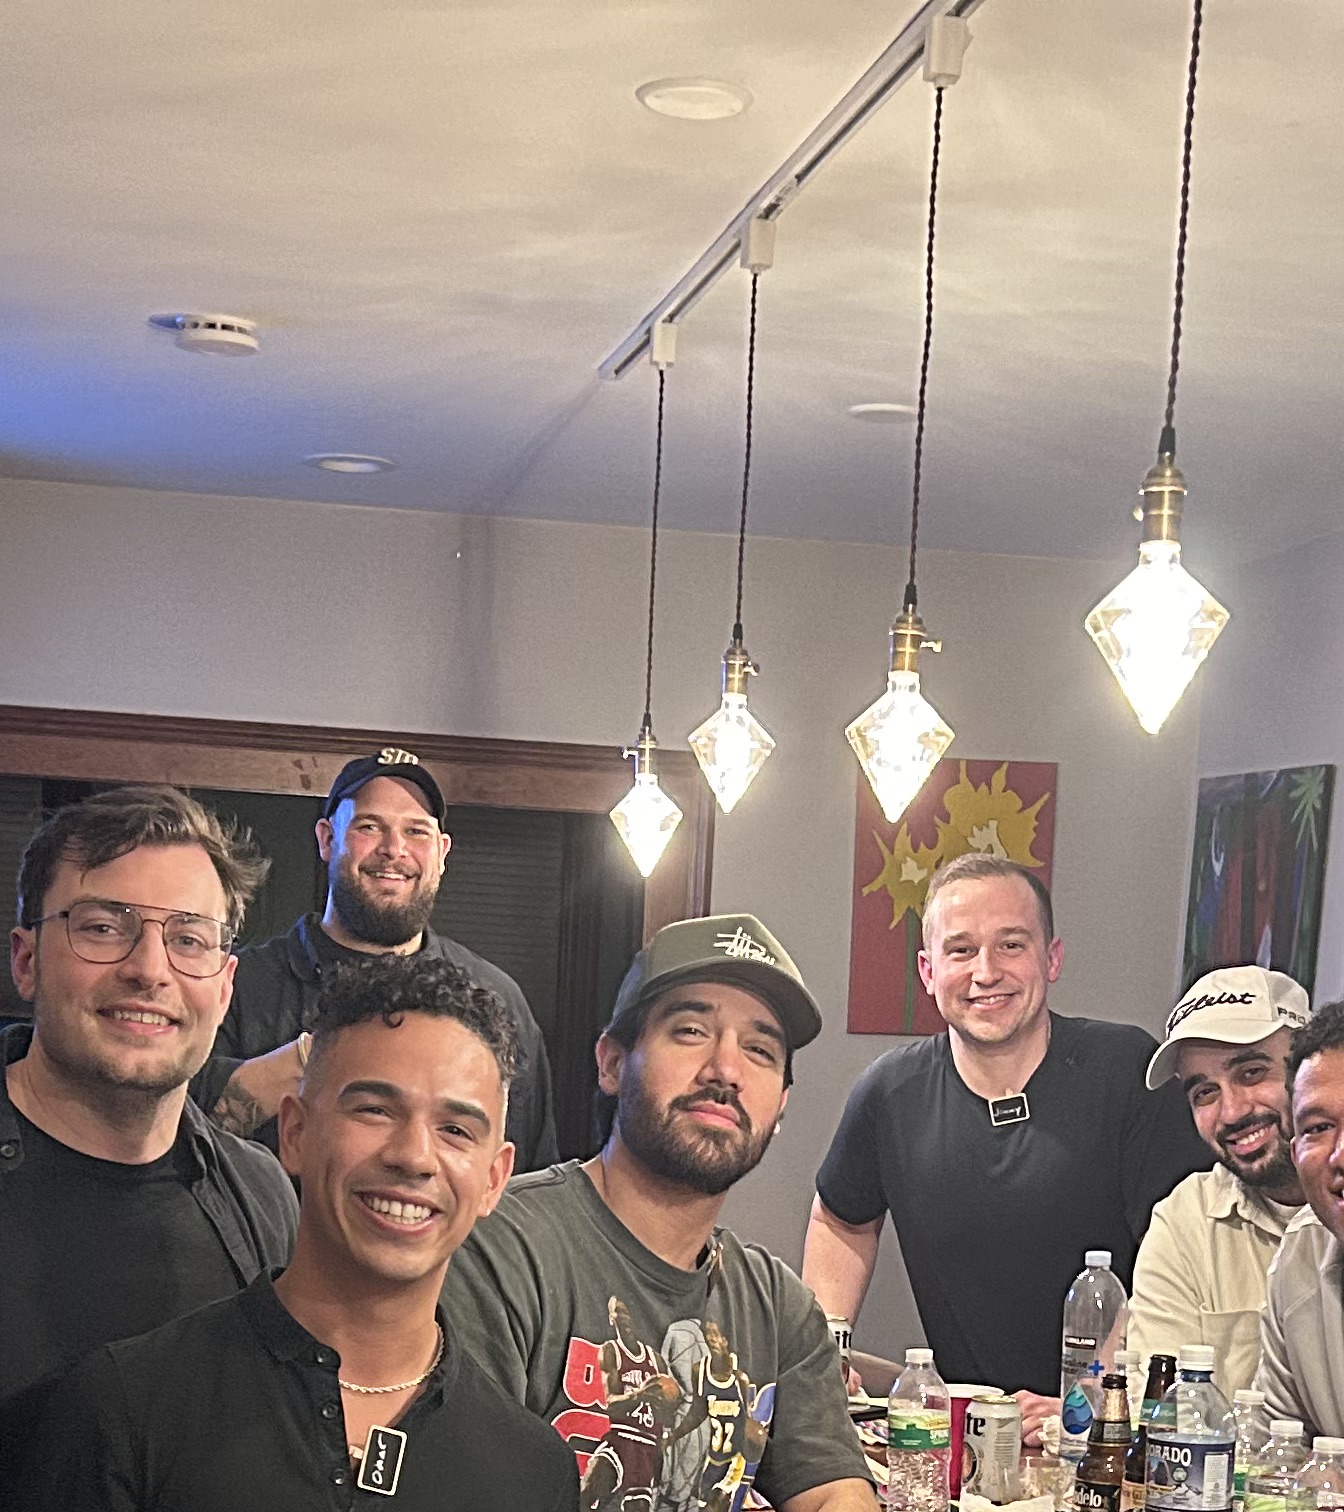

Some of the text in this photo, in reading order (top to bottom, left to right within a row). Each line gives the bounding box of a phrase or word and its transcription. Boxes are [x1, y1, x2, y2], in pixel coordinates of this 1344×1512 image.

[1276, 1006, 1306, 1025] PRO
[834, 1330, 853, 1349] it
[710, 1417, 736, 1454] 32
[966, 1412, 987, 1437] te
[1148, 1443, 1192, 1468] ORADO
[1075, 1486, 1103, 1508] delo
